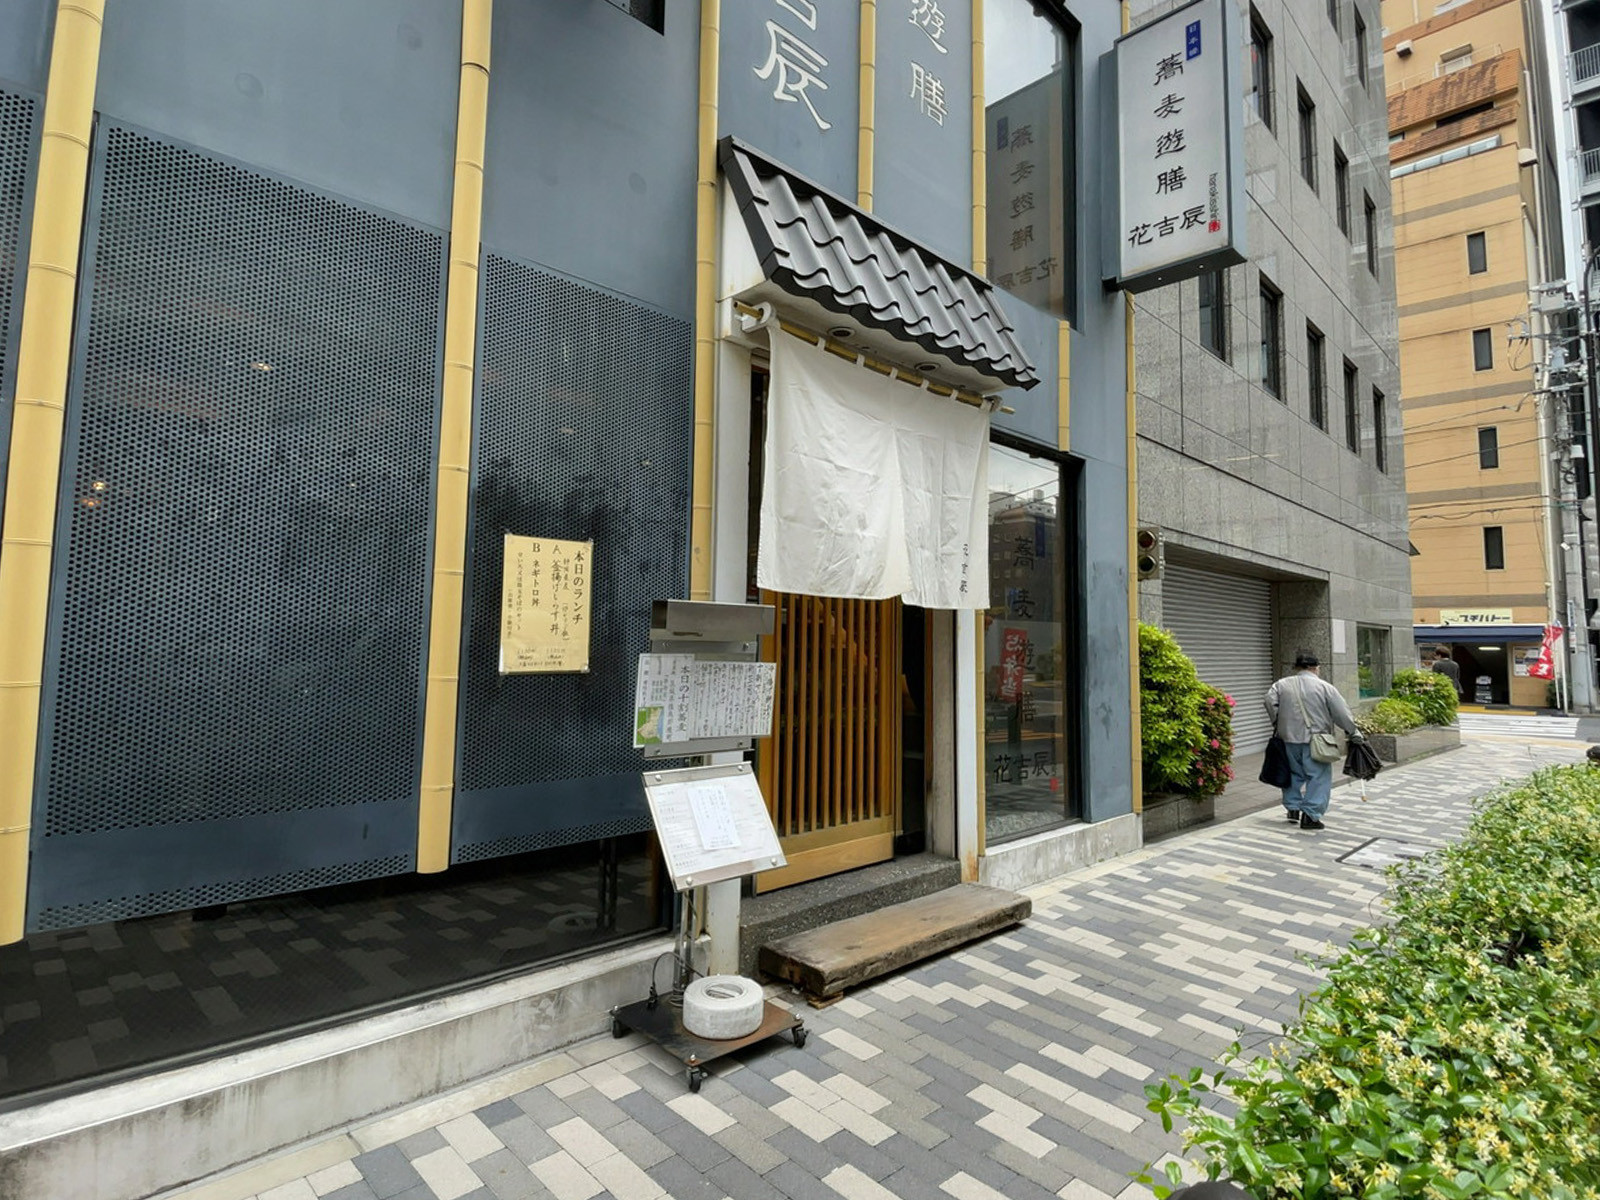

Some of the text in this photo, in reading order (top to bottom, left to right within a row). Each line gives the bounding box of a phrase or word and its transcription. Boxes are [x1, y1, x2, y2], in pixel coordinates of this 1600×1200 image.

[753, 0, 833, 130] 辰
[1153, 51, 1187, 195] 蕎麦遊膳
[1127, 204, 1208, 248] 花吉辰
[531, 542, 541, 607] B ネギトロ丼
[552, 544, 562, 555] A
[572, 550, 585, 625] 本日のランチ
[993, 750, 1050, 784] 花吉辰
